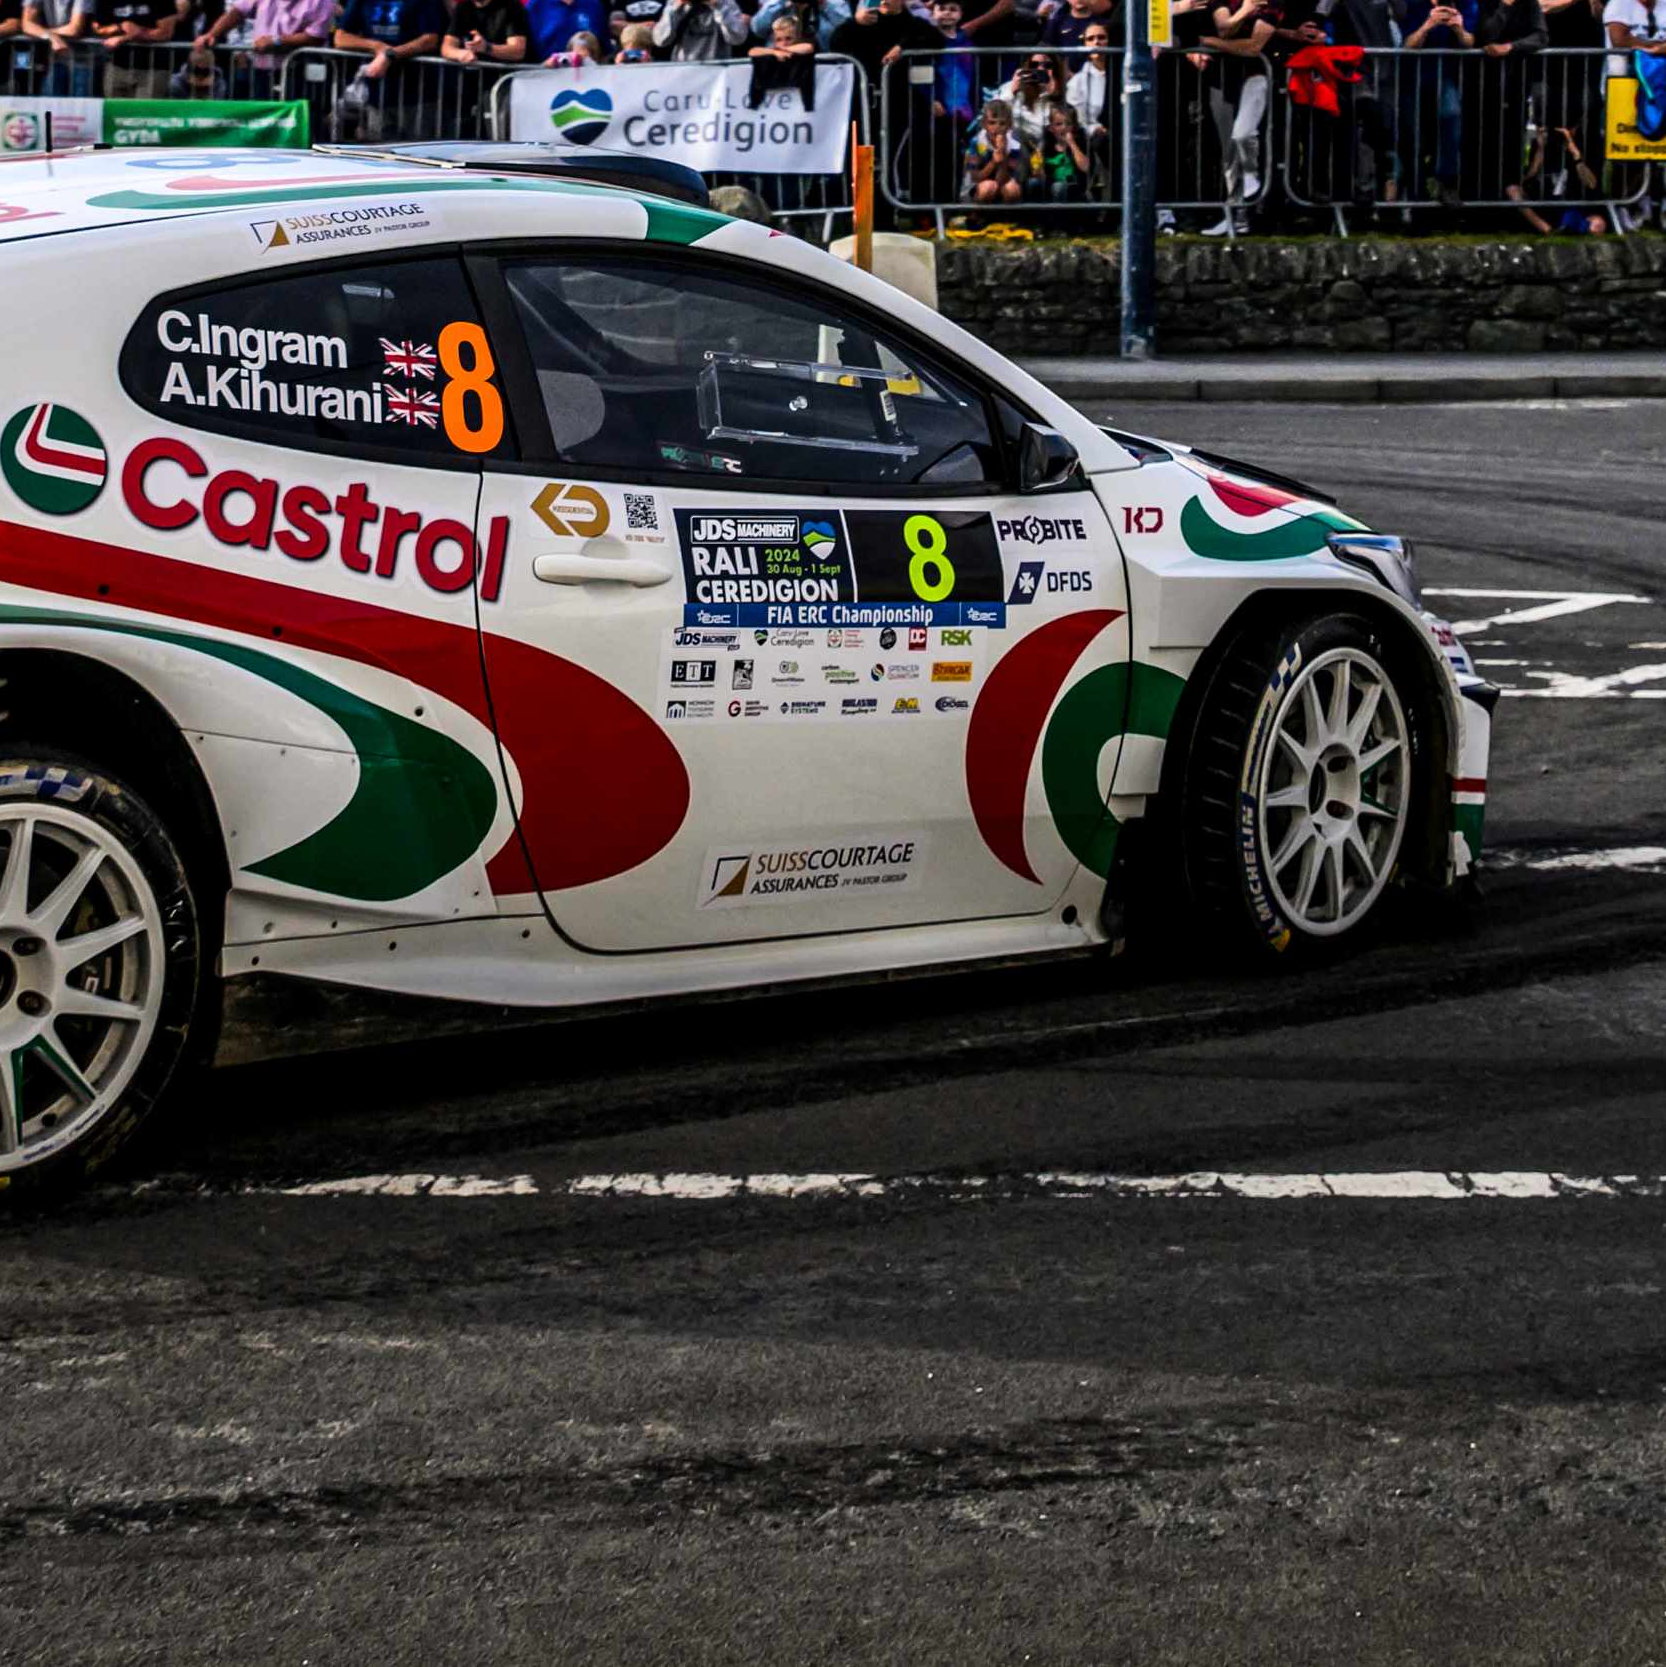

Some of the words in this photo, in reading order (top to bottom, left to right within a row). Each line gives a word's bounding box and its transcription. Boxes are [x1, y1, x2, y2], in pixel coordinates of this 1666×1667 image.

[623, 112, 814, 152] Ceredigion
[1611, 143, 1629, 153] No
[285, 203, 425, 231] SUISSCOURTAGE
[296, 225, 372, 245] ASSURANCES
[157, 310, 348, 369] C.Ingram
[160, 362, 382, 424] A.Kihurani
[438, 321, 504, 453] 8
[122, 437, 511, 603] Castrol
[694, 519, 736, 541] JDS
[737, 523, 796, 538] MACHINERY
[692, 547, 759, 575] RALI
[765, 549, 801, 562] 2024
[767, 564, 780, 574] 30
[782, 564, 802, 576] Aug
[811, 564, 817, 574] 1
[819, 563, 842, 577] Sept
[904, 515, 955, 602] 8
[696, 579, 840, 604] CEREDIGION
[1047, 571, 1093, 592] DFDS
[767, 606, 794, 624] FIA
[798, 606, 827, 624] ERC
[832, 605, 933, 627] Championship
[675, 633, 702, 646] JDS
[909, 628, 926, 643] DC
[941, 630, 973, 646] RSK
[674, 664, 714, 679] ETT
[755, 842, 915, 875] SUISSCOURTAGE
[1241, 803, 1274, 922] MICHELIN
[751, 874, 840, 895] ASSURANCES
